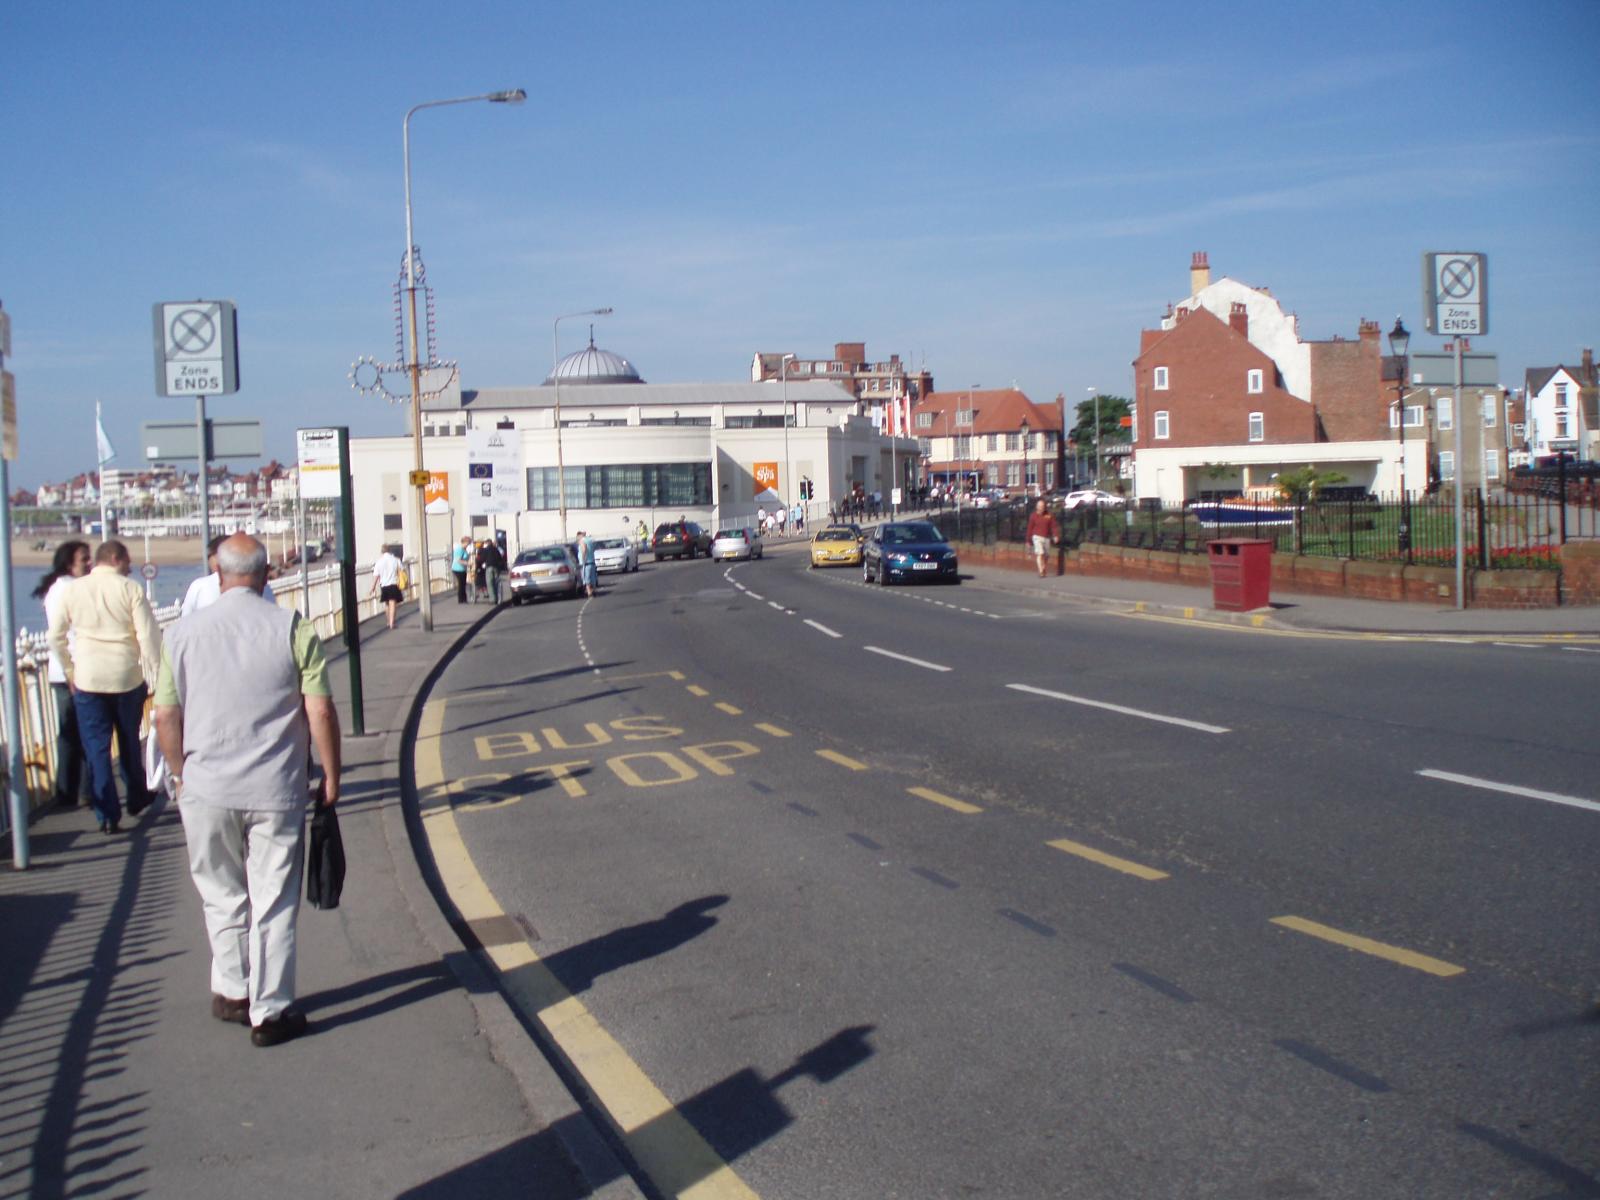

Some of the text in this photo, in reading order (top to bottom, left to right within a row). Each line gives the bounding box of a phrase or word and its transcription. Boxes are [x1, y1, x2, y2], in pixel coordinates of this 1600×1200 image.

[1448, 308, 1470, 317] Zone
[1443, 319, 1477, 330] ENDS
[180, 366, 209, 376] Zone
[175, 377, 219, 390] ENDS
[474, 716, 684, 761] BUS
[449, 741, 760, 812] STOP
